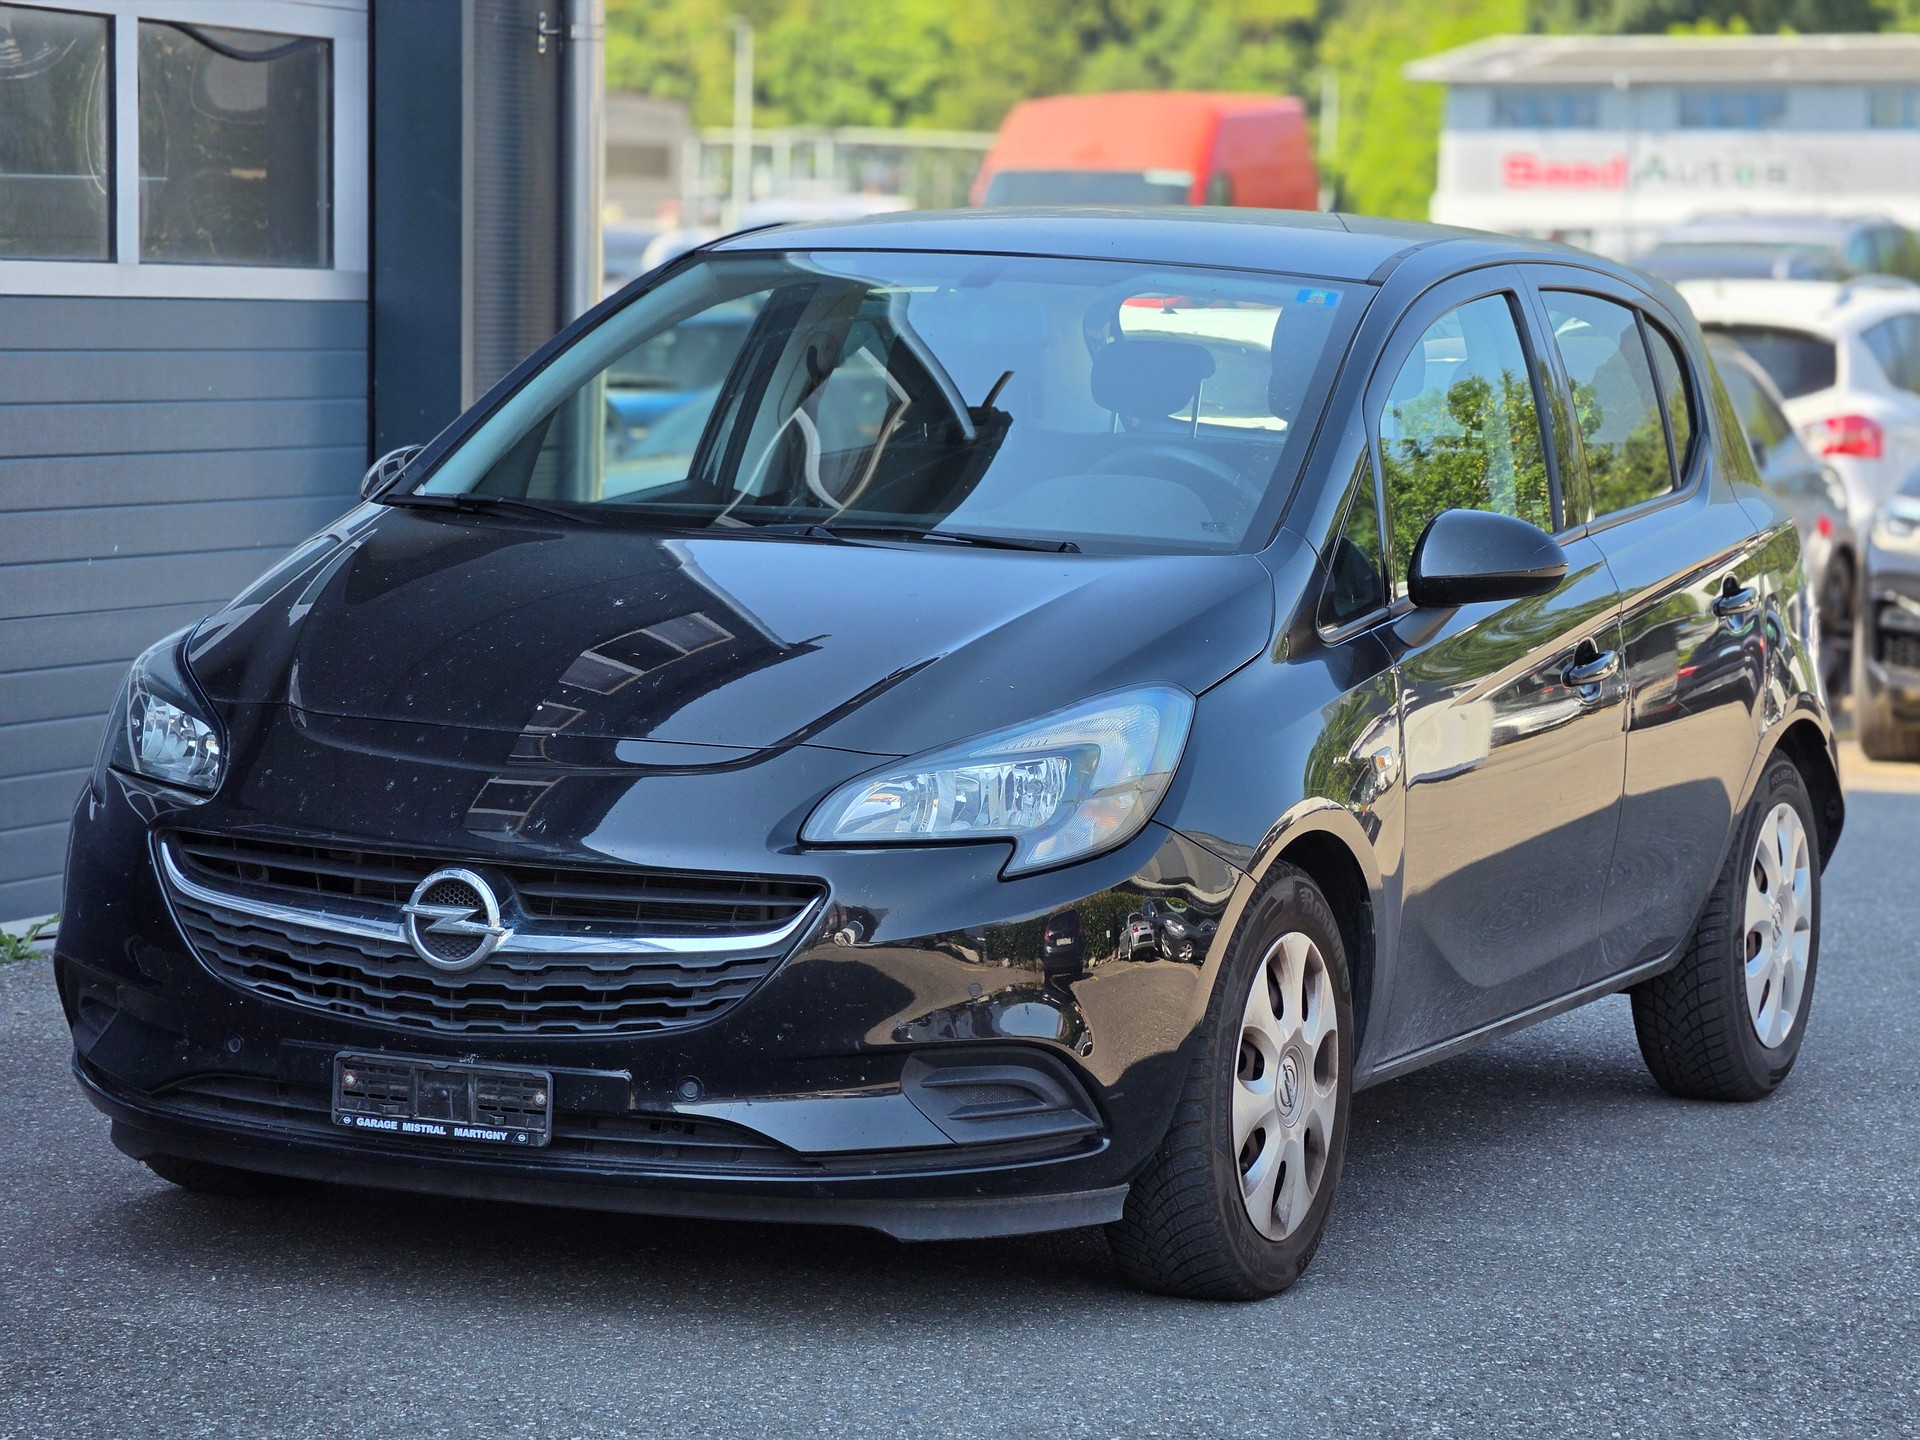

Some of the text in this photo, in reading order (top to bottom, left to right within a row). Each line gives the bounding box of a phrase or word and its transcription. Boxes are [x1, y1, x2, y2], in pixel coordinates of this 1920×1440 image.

[356, 1117, 508, 1142] GARAGE MISTRAL MARTIGNY
